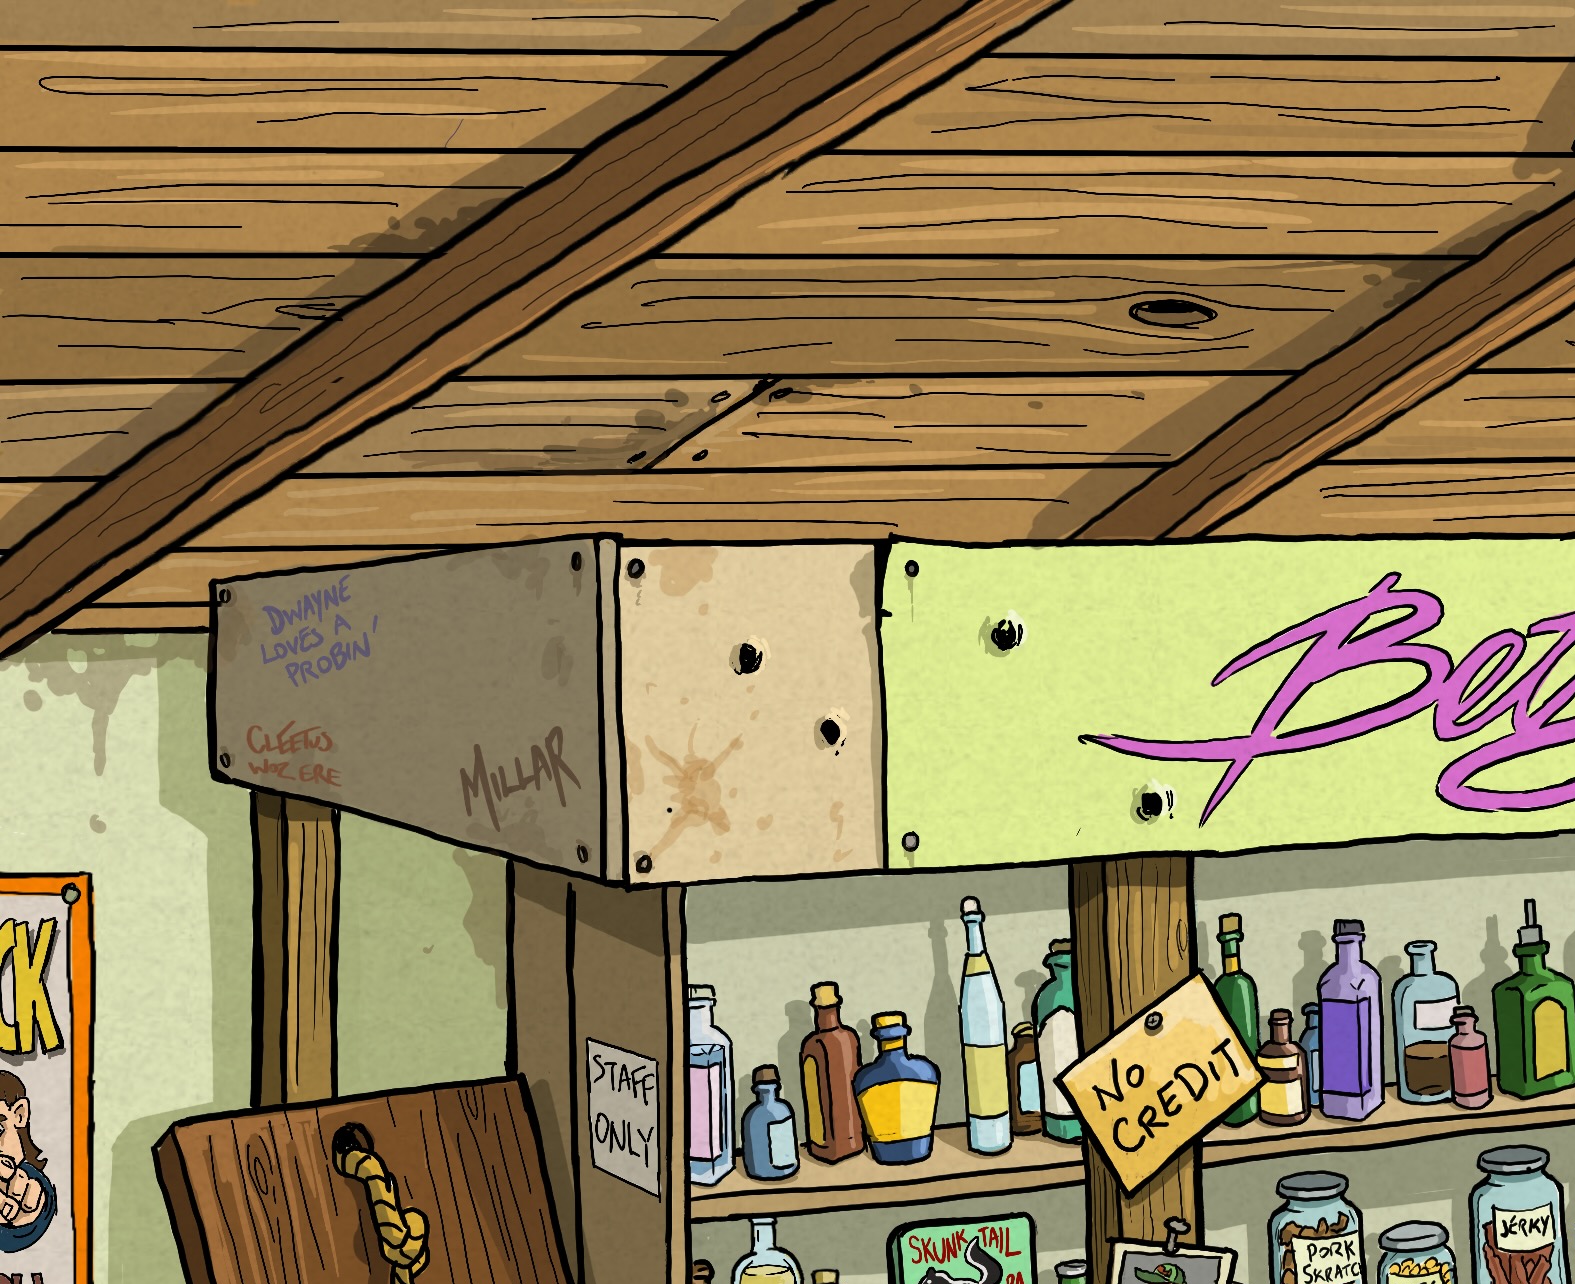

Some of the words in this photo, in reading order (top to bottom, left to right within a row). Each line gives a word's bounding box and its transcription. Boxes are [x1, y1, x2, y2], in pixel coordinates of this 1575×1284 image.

[262, 575, 351, 635] DWAYNE
[261, 627, 323, 663] LOVES
[335, 615, 351, 636] A
[247, 721, 332, 753] CLEETUS
[300, 763, 341, 787] ERE
[593, 1054, 654, 1106] STAFF
[1113, 1038, 1239, 1152] CREDIT
[595, 1112, 654, 1168] ONLY
[909, 1229, 968, 1264] SKUNK
[978, 1226, 1022, 1257] TAIL
[1302, 1262, 1361, 1284] SKRATC
